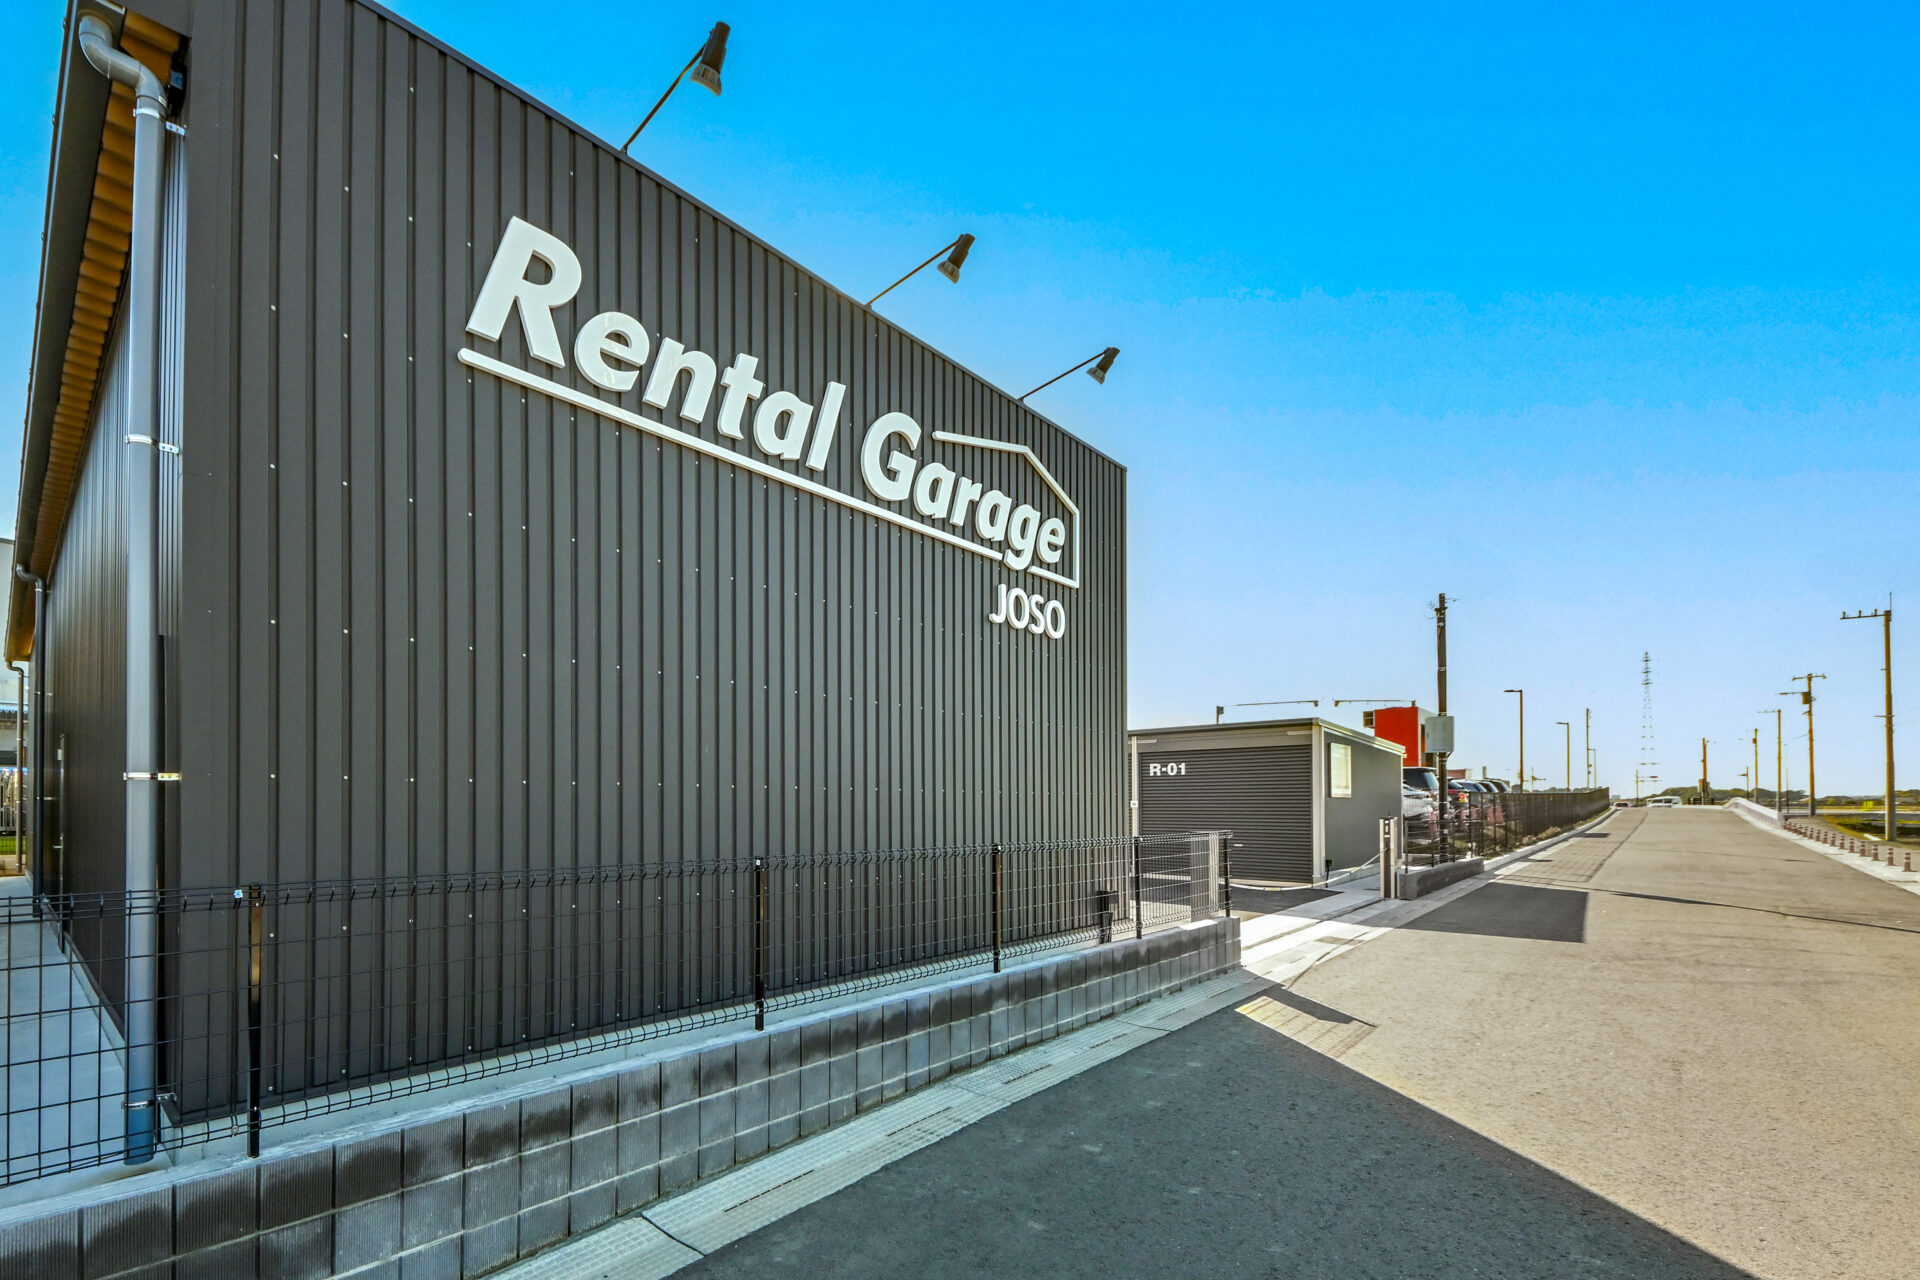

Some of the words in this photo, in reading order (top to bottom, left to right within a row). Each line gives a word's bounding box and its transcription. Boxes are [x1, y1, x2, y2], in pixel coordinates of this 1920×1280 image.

[466, 216, 846, 472] Rental
[861, 411, 1066, 571] Garage
[990, 583, 1066, 640] JOSO
[1149, 762, 1186, 776] R-01
